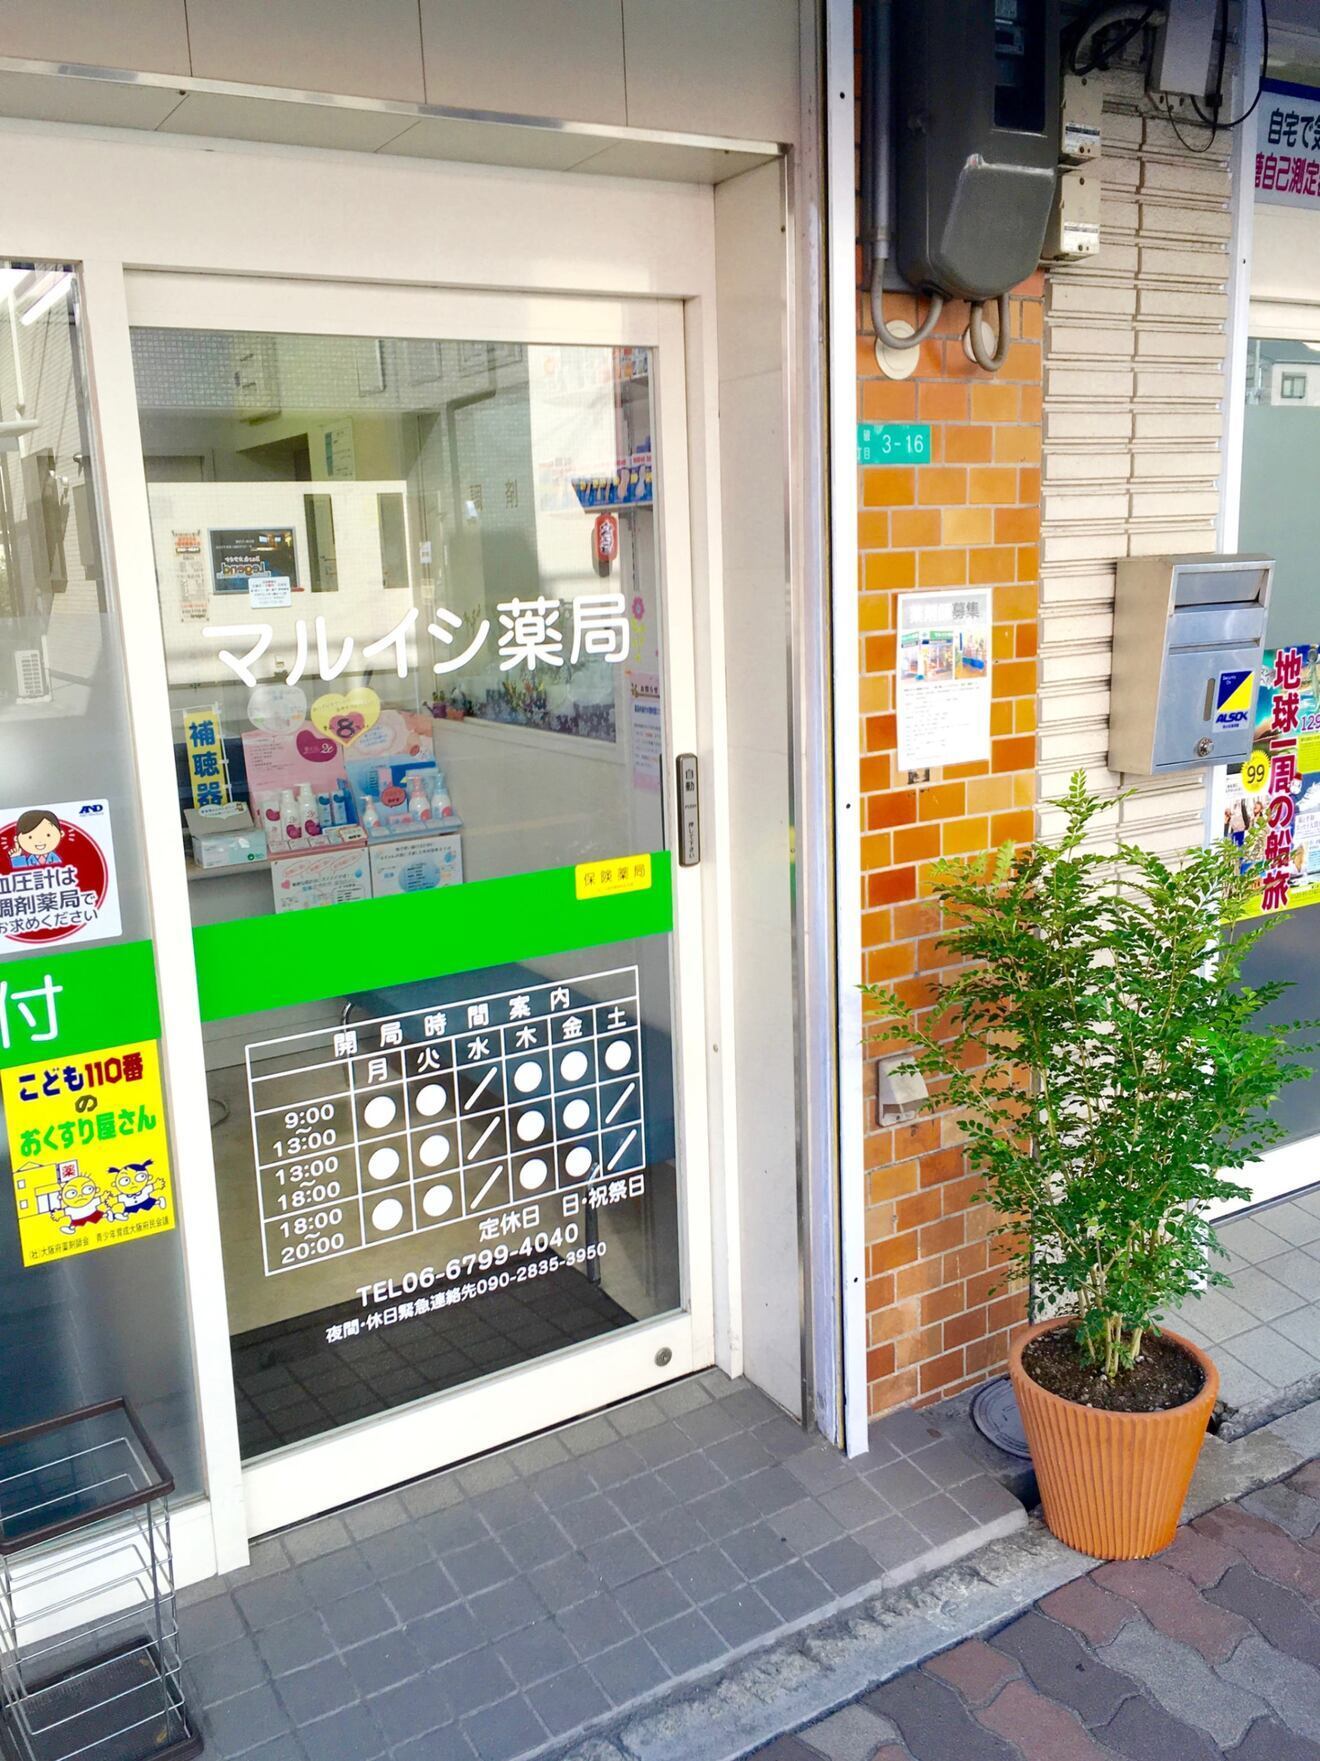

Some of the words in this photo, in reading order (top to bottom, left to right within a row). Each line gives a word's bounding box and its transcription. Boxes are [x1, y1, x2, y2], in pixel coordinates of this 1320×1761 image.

[881, 434, 924, 453] 3-16
[202, 593, 631, 688] マルイシ薬局
[1215, 711, 1249, 724] ALSOK
[189, 719, 223, 808] 補聴器
[1246, 764, 1266, 784] 99
[1260, 648, 1302, 912] 地球一周の船旅
[584, 863, 646, 888] 保険薬局
[0, 973, 64, 1050] 付
[606, 1006, 628, 1030] 土
[515, 1026, 538, 1049] 木
[561, 1016, 585, 1041] 金
[416, 1047, 441, 1072] 火
[467, 1036, 490, 1061] 水
[18, 1051, 144, 1102] こども110番
[367, 1058, 389, 1084] 月
[75, 1094, 98, 1114] の
[284, 1104, 336, 1131] 9:00
[20, 1104, 157, 1158] おくすり屋さん
[272, 1129, 337, 1159] 13:00
[275, 1156, 339, 1186] 13:00
[277, 1181, 341, 1212] 18:00
[279, 1208, 343, 1239] 18:00
[478, 1205, 540, 1242] 定休日
[280, 1232, 345, 1265] 20:00
